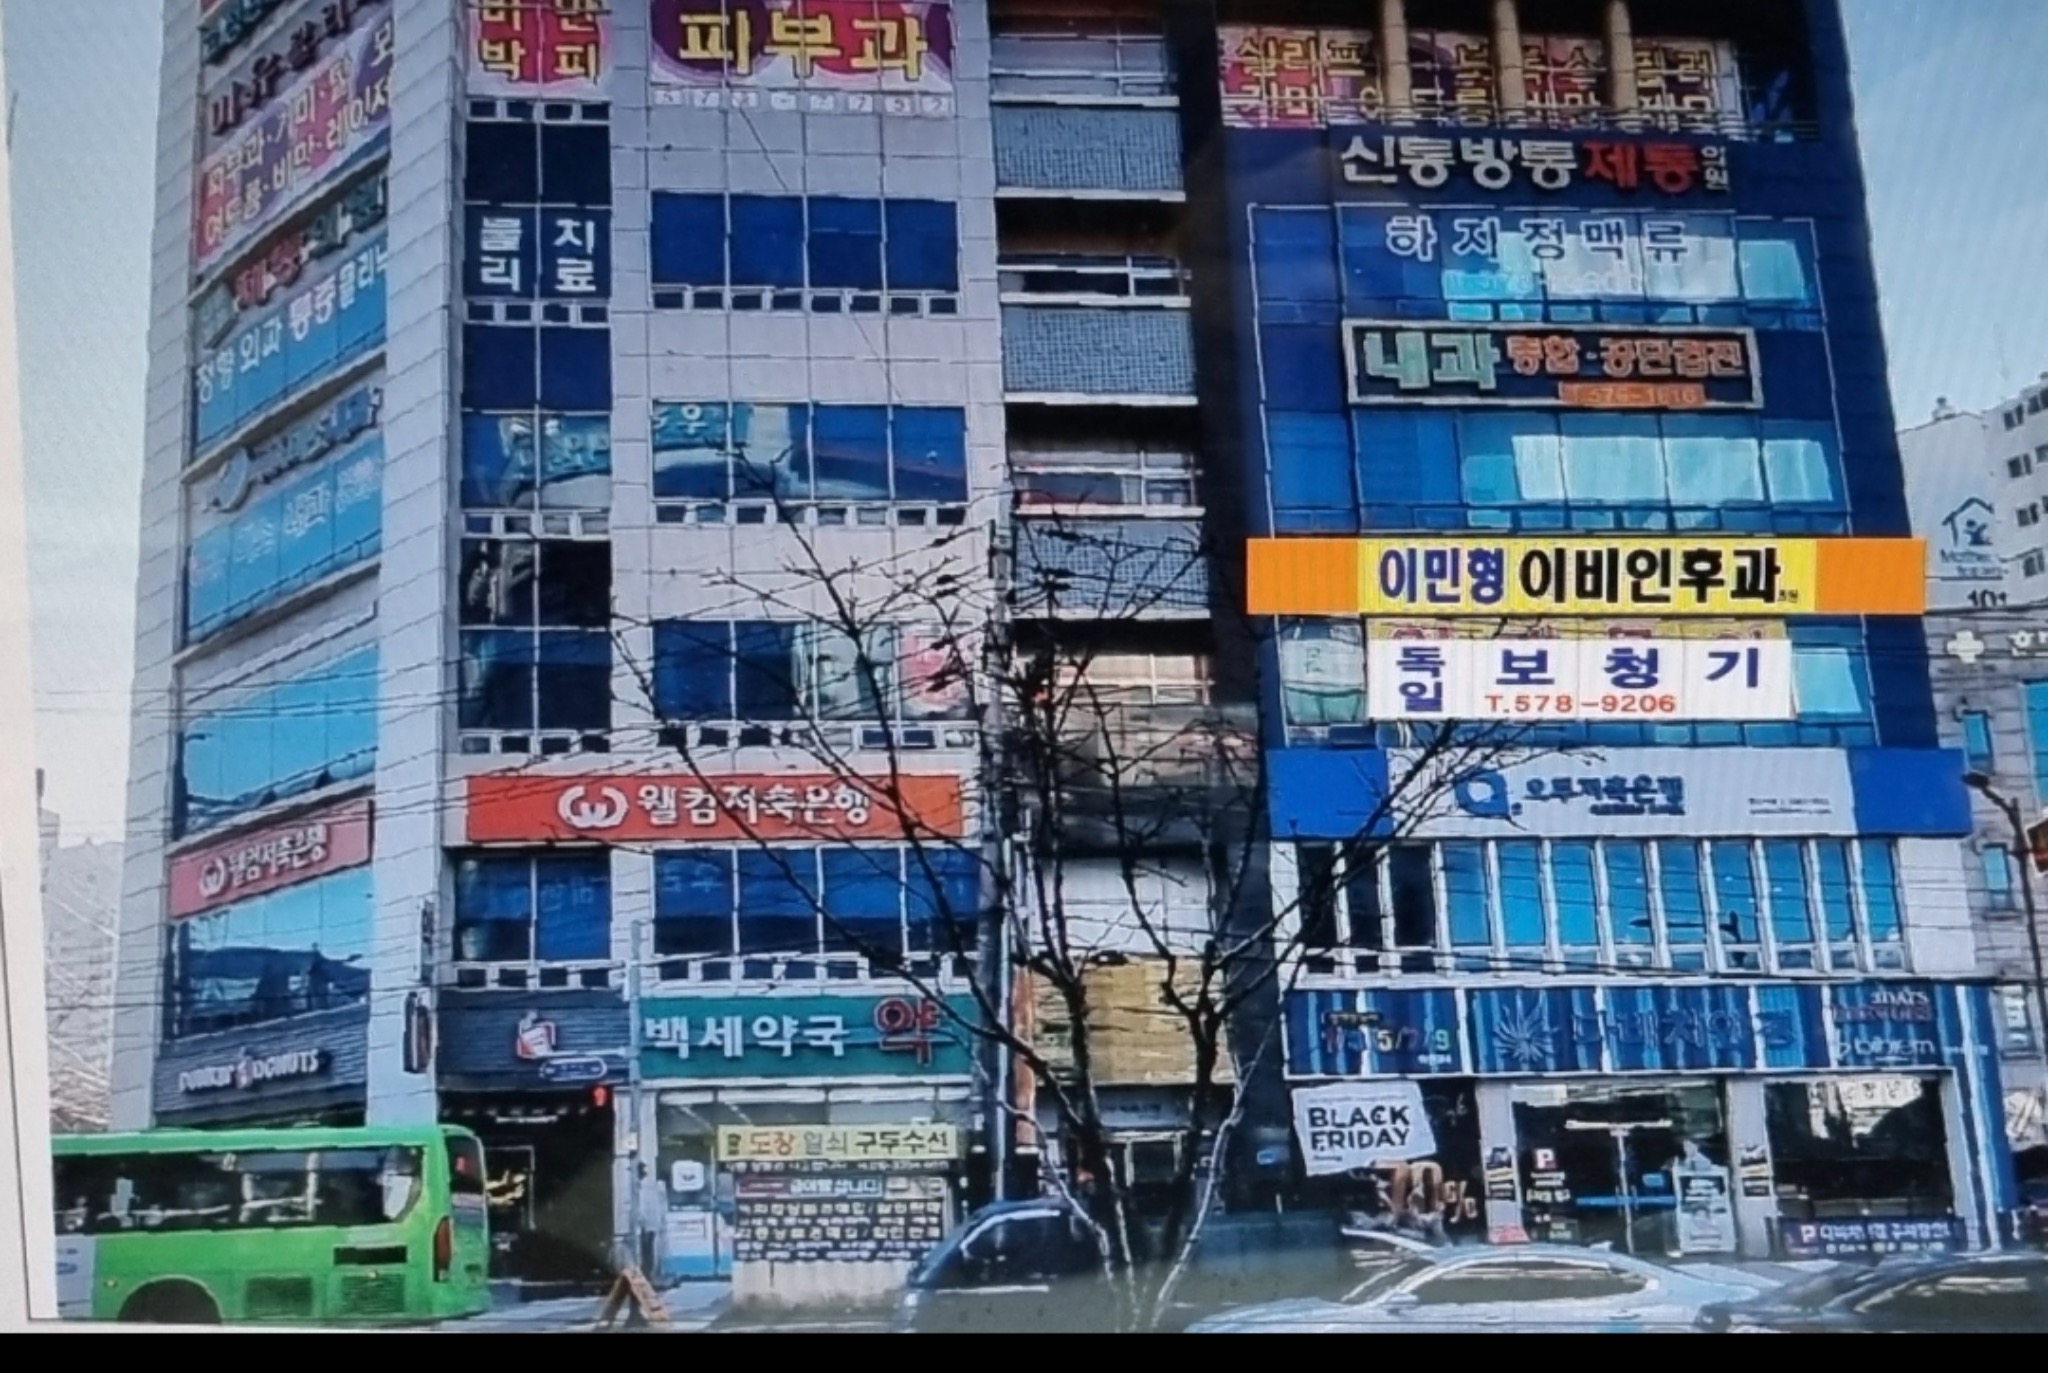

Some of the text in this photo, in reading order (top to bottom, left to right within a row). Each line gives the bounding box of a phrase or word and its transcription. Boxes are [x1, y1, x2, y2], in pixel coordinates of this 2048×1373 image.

[478, 38, 598, 84] 박피
[678, 9, 929, 80] 피부과
[1385, 214, 1690, 263] 하지정맥류
[1363, 331, 1500, 390] 내과
[1380, 547, 1504, 602] 이민형
[1519, 547, 1781, 603] 이비인후과
[1396, 646, 1446, 713] 독일
[1496, 647, 1760, 690] 보청기
[1485, 695, 1677, 714] T.578-9206
[638, 785, 871, 826] 웰컴저축은행
[645, 1015, 850, 1058] 백세약국
[1308, 1105, 1410, 1130] BLACK
[750, 1131, 794, 1156] 도장
[855, 1130, 949, 1155] 구두수선
[1311, 1129, 1410, 1151] FRIDAY
